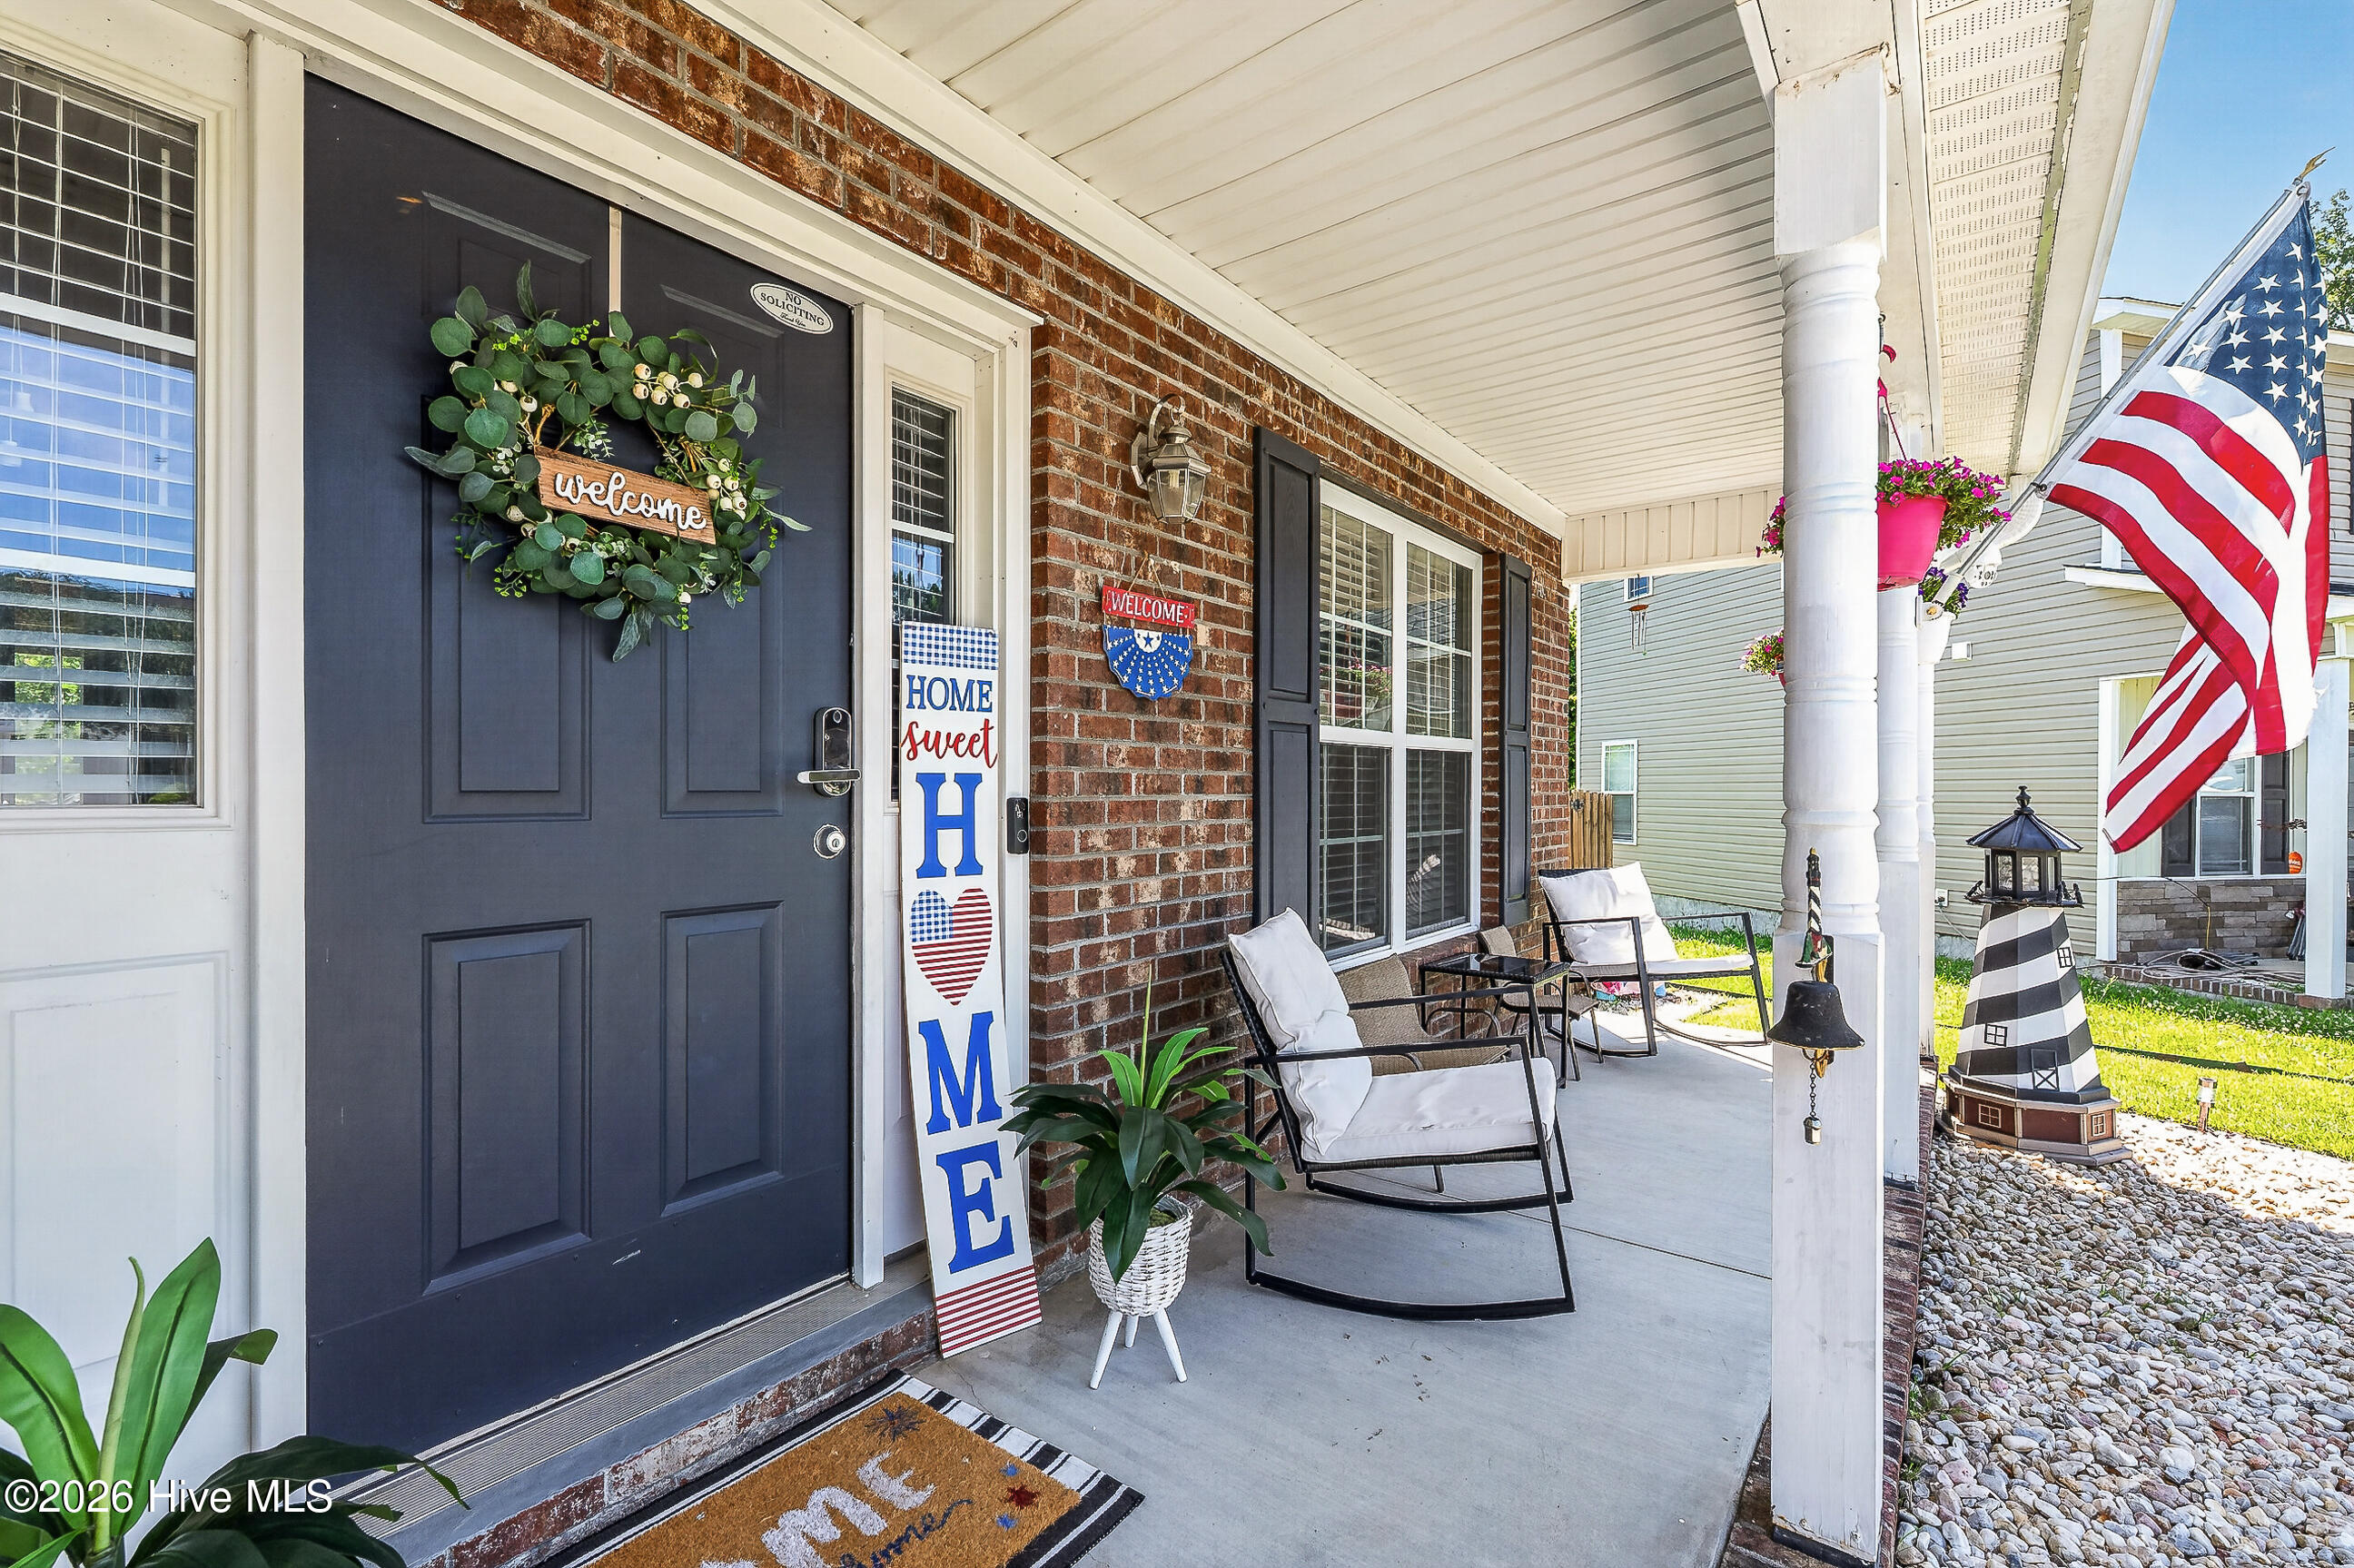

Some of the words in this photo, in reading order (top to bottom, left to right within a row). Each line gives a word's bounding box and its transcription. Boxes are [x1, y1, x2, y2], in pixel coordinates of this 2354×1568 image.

[760, 292, 825, 326] SOLICITING
[786, 292, 801, 306] NO
[554, 471, 707, 530] welcome
[1111, 591, 1186, 624] WELCOME
[906, 674, 993, 713] HOME
[901, 718, 998, 769] sweet
